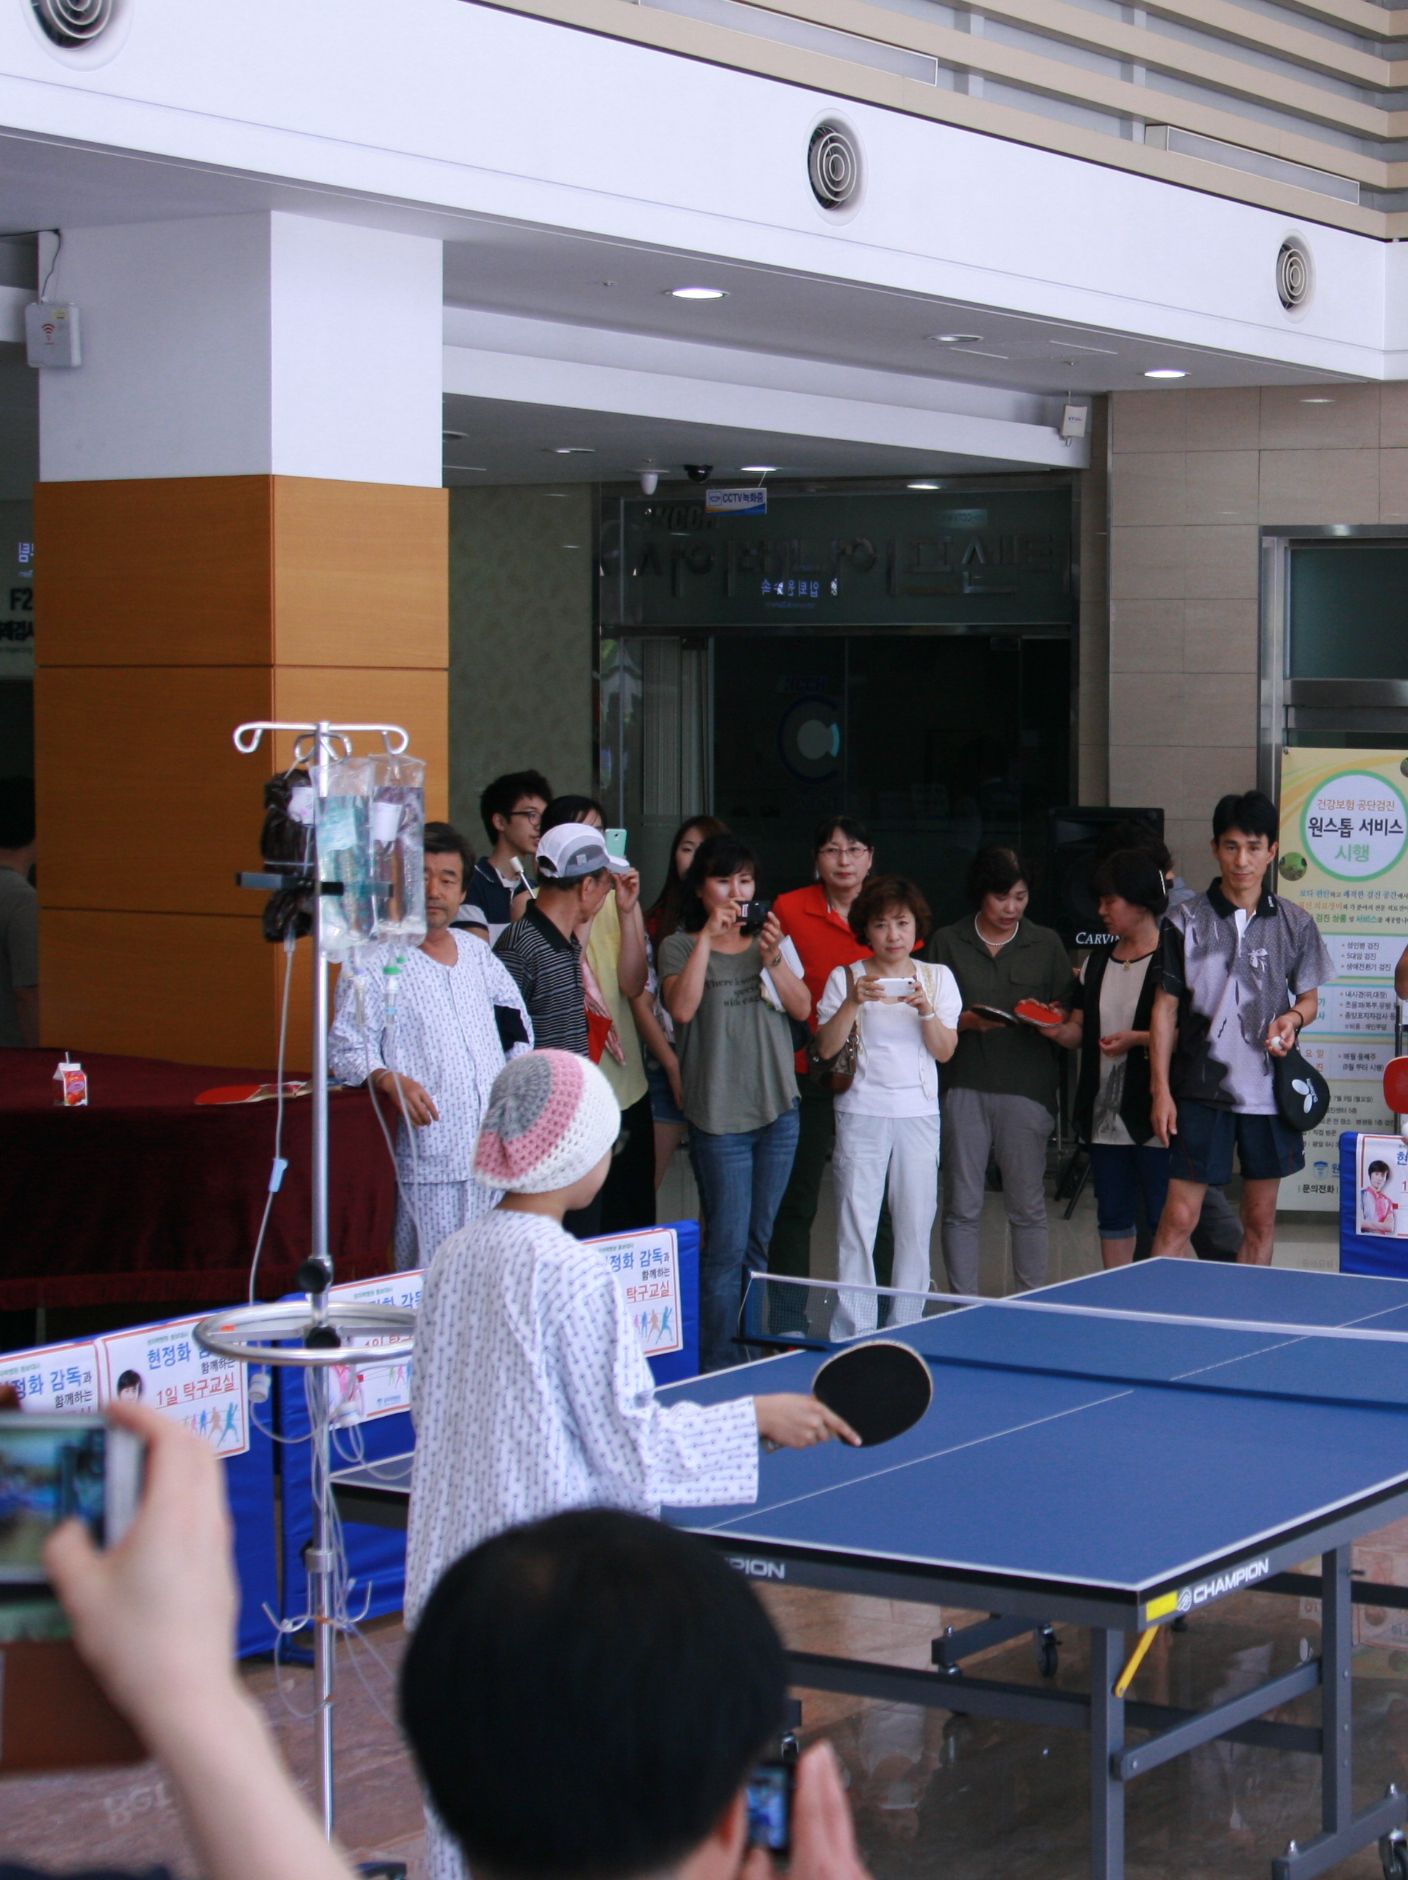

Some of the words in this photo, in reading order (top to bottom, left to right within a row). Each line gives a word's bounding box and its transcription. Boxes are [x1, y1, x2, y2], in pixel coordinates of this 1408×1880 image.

[1317, 799, 1354, 811] 건강보험
[1356, 800, 1396, 812] 공단검진
[1308, 816, 1354, 838] 원스톱
[1359, 817, 1404, 836] 서비스
[1334, 843, 1370, 863] 시행
[1302, 1184, 1335, 1194] 문의전화
[606, 1251, 634, 1273] 정화
[640, 1247, 670, 1268] 감독과
[641, 1267, 671, 1281] 함께하는
[626, 1280, 670, 1302] 탁구교실
[147, 1341, 192, 1370] 현정화
[0, 1373, 44, 1400] 정화
[50, 1366, 93, 1393] 감독과
[156, 1387, 179, 1408] 1일
[183, 1373, 236, 1399] 탁구교실
[55, 1389, 94, 1409] 함께하는
[729, 1556, 785, 1580] PION
[1192, 1558, 1270, 1606] CHAMPION
